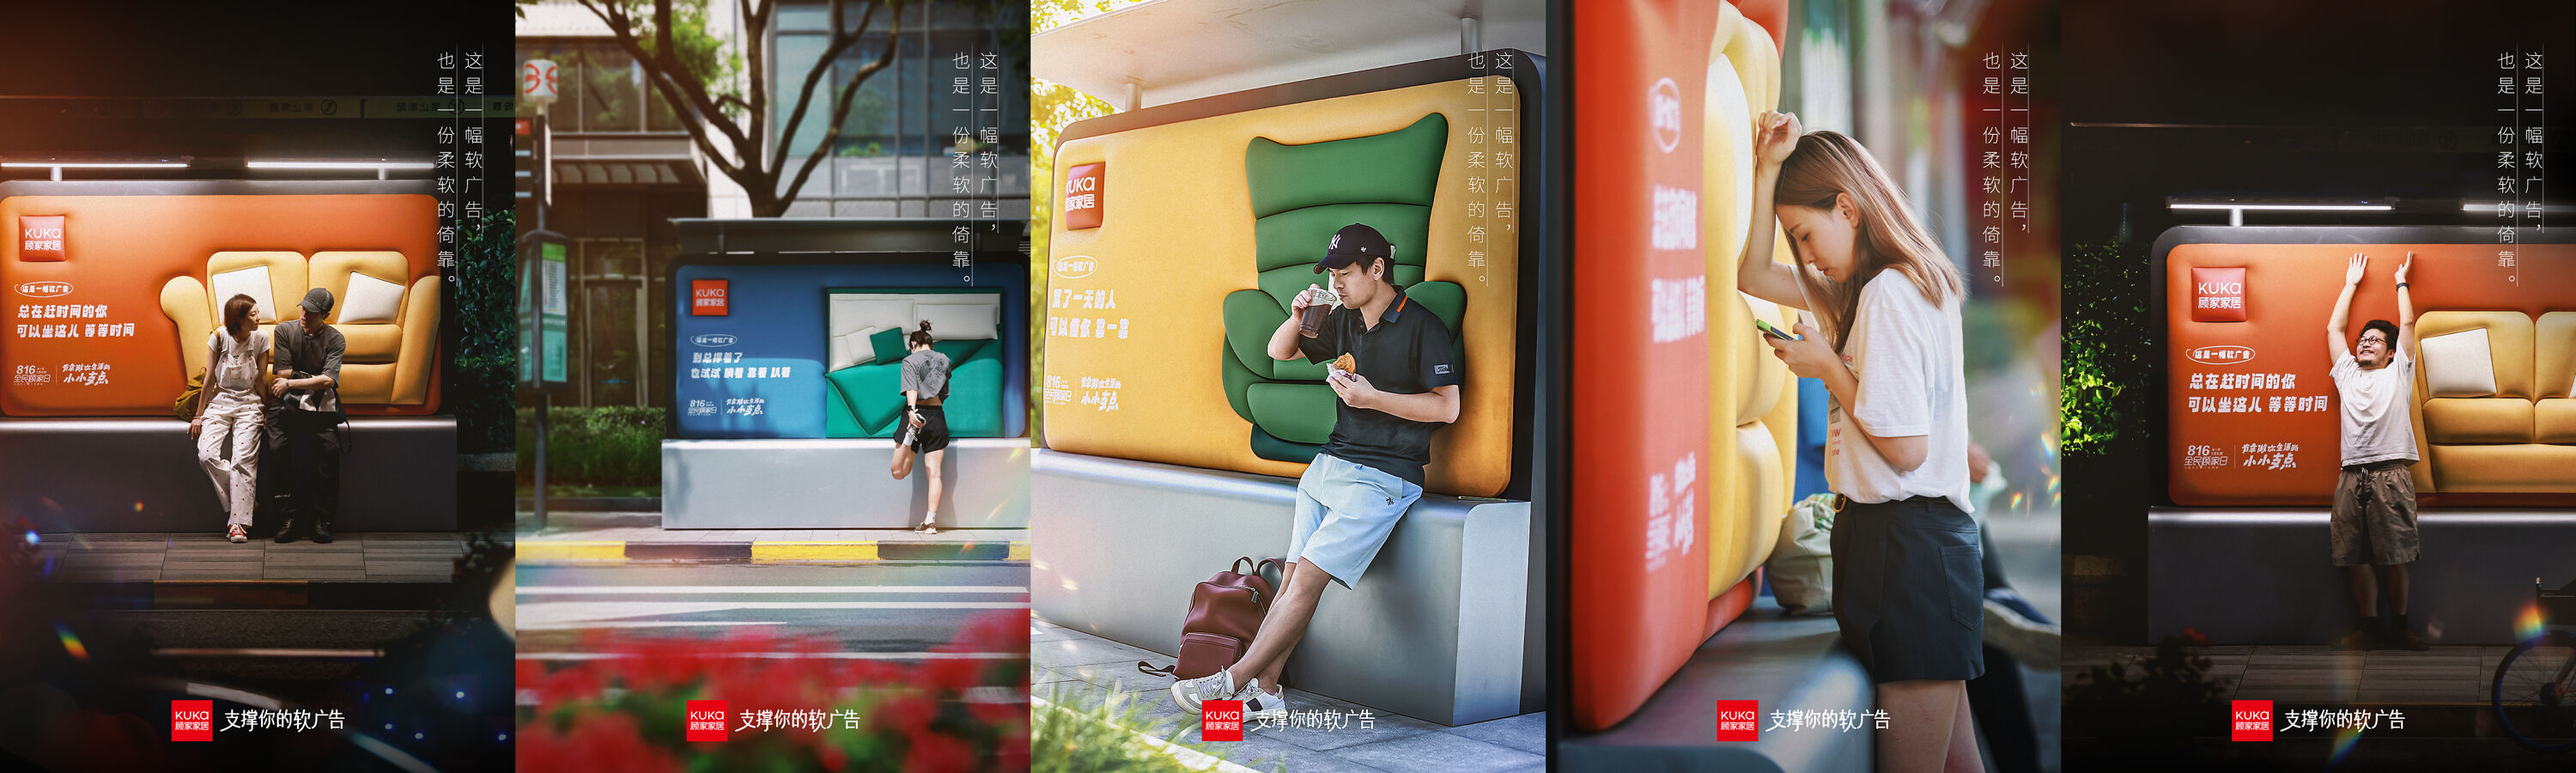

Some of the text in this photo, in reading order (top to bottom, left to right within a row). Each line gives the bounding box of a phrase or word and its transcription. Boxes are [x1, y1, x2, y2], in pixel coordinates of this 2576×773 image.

[1052, 289, 1116, 309] 累了一天的人
[2197, 297, 2241, 308] 顾家家居
[17, 304, 108, 319] 总在赶时间的你
[16, 322, 135, 338] 可以坐这儿 等等时间
[1095, 318, 1129, 339] 靠一靠
[16, 365, 36, 374] 816
[2190, 373, 2296, 389] 总在赶时间的你
[2189, 396, 2328, 413] 可以坐这儿 等等时间
[2187, 445, 2210, 455] 816
[2243, 453, 2297, 470] 小小支点
